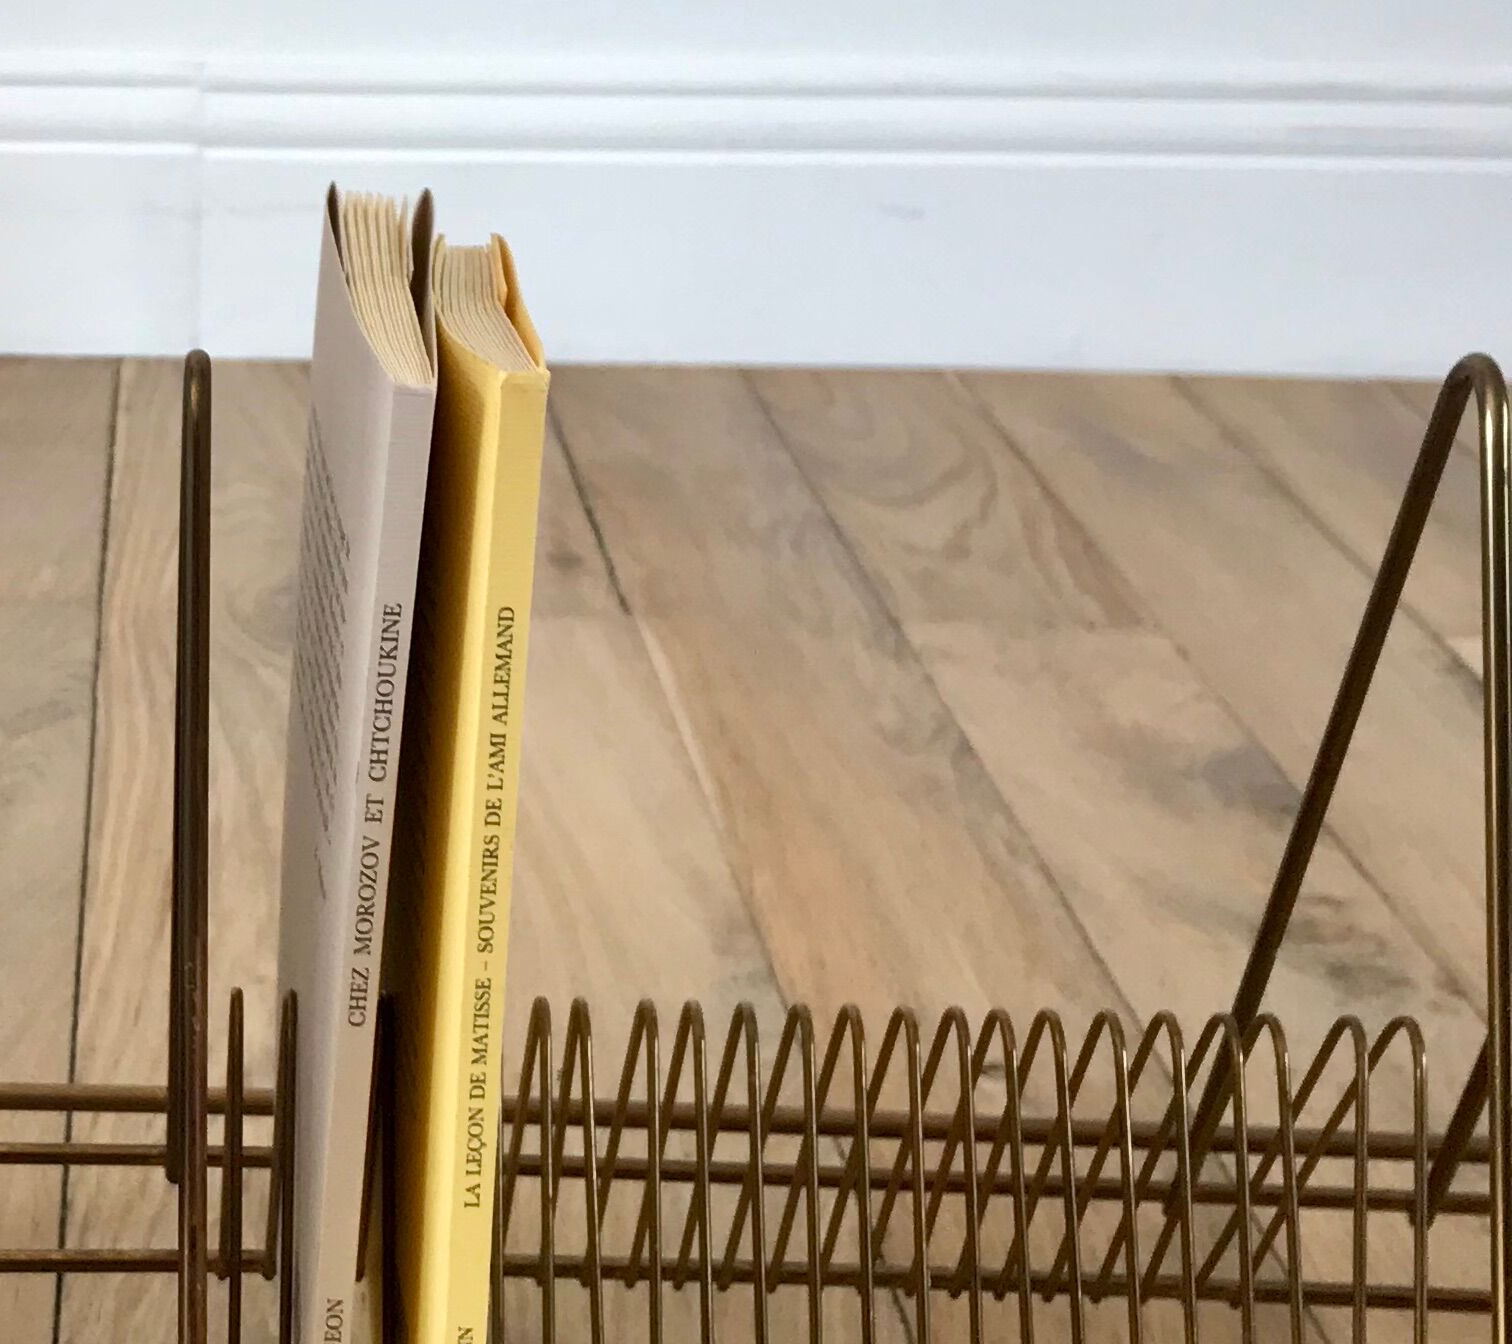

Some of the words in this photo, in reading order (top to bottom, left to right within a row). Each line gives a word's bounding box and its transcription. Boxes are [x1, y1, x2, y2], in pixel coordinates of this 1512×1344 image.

[368, 602, 403, 783] CHTCHOUKINE
[491, 605, 515, 726] ALLEMAND
[486, 731, 508, 792] L'AMI
[364, 792, 385, 825] ET
[483, 799, 503, 828] DE
[353, 836, 380, 955] MOROZOV
[476, 834, 501, 954] SOUVENIRS
[348, 966, 371, 1028] CHEZ
[471, 976, 493, 1067] MATISSE
[468, 1070, 486, 1101] DE
[466, 1104, 487, 1176] LEÇON
[463, 1178, 481, 1209] LA
